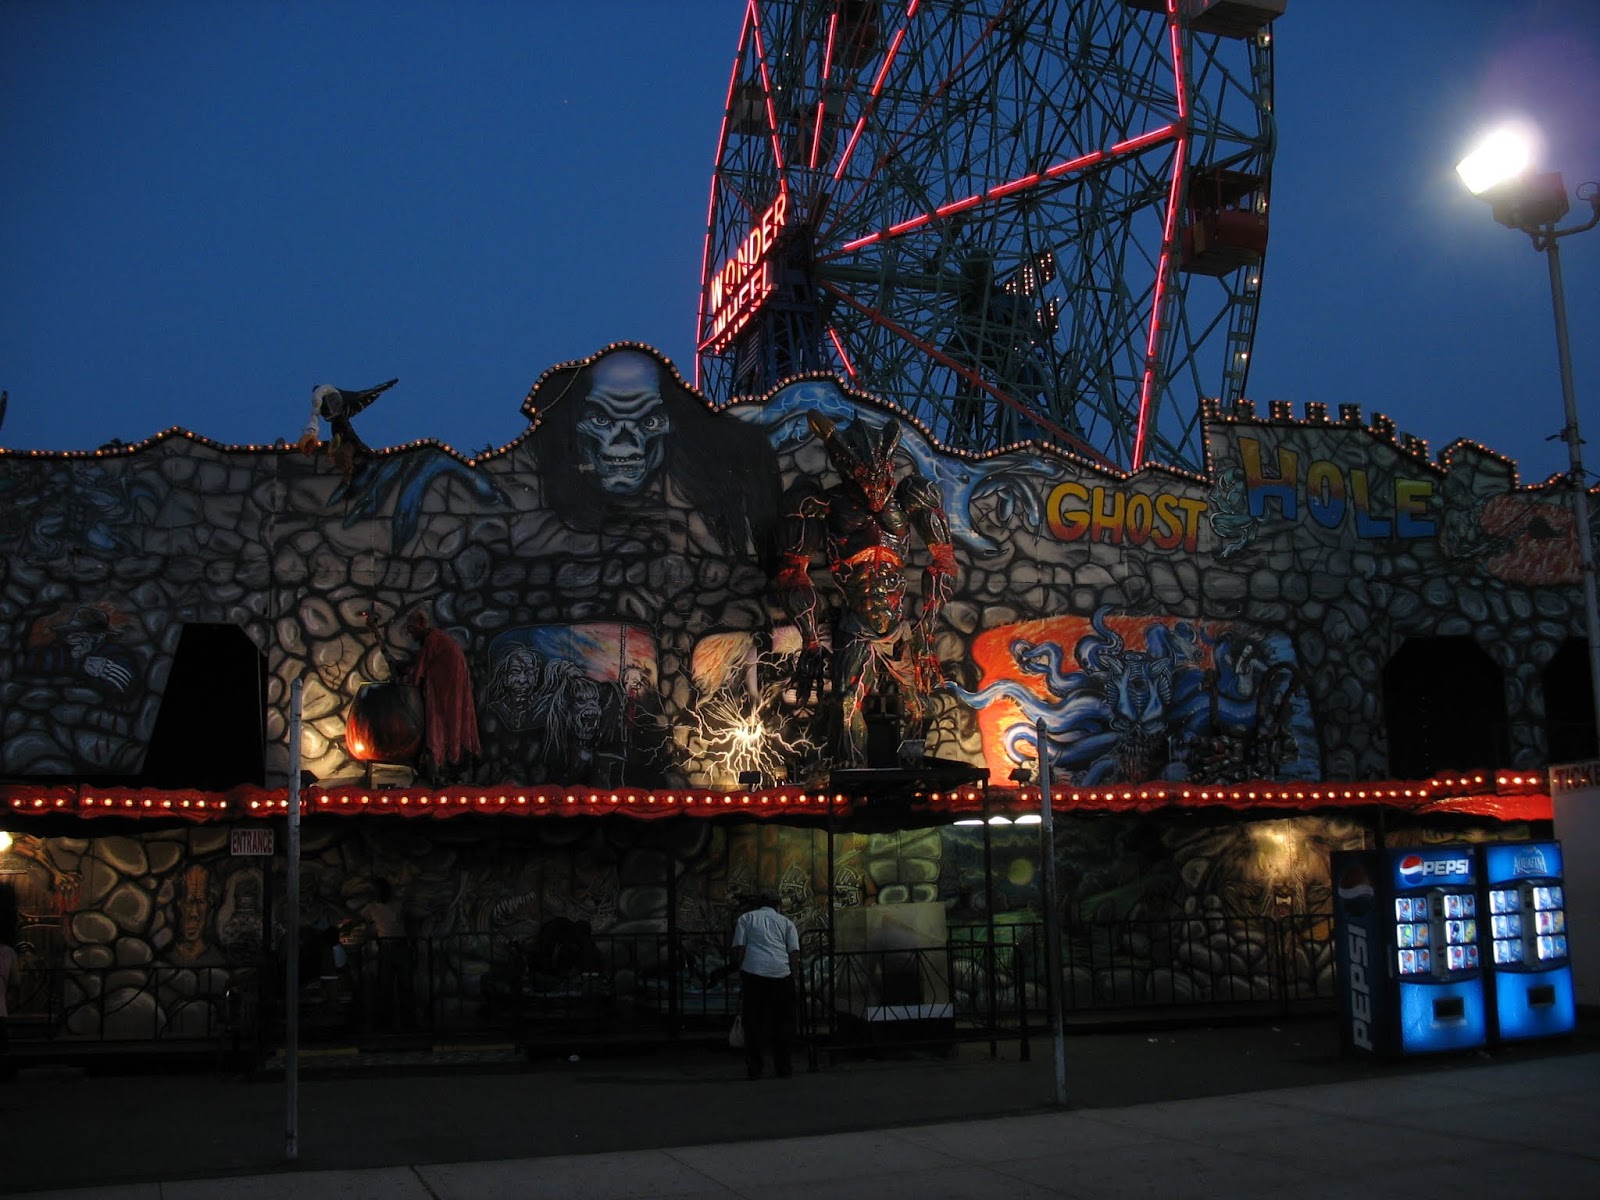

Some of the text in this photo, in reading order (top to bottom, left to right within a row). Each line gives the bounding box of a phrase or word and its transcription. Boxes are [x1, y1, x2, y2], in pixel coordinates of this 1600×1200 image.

[710, 193, 786, 313] WONDER
[1046, 437, 1437, 554] GHOST HOLE
[231, 830, 274, 855] ENTRANCE
[1422, 858, 1469, 877] PEPSI
[1348, 923, 1373, 1051] PEPSI
